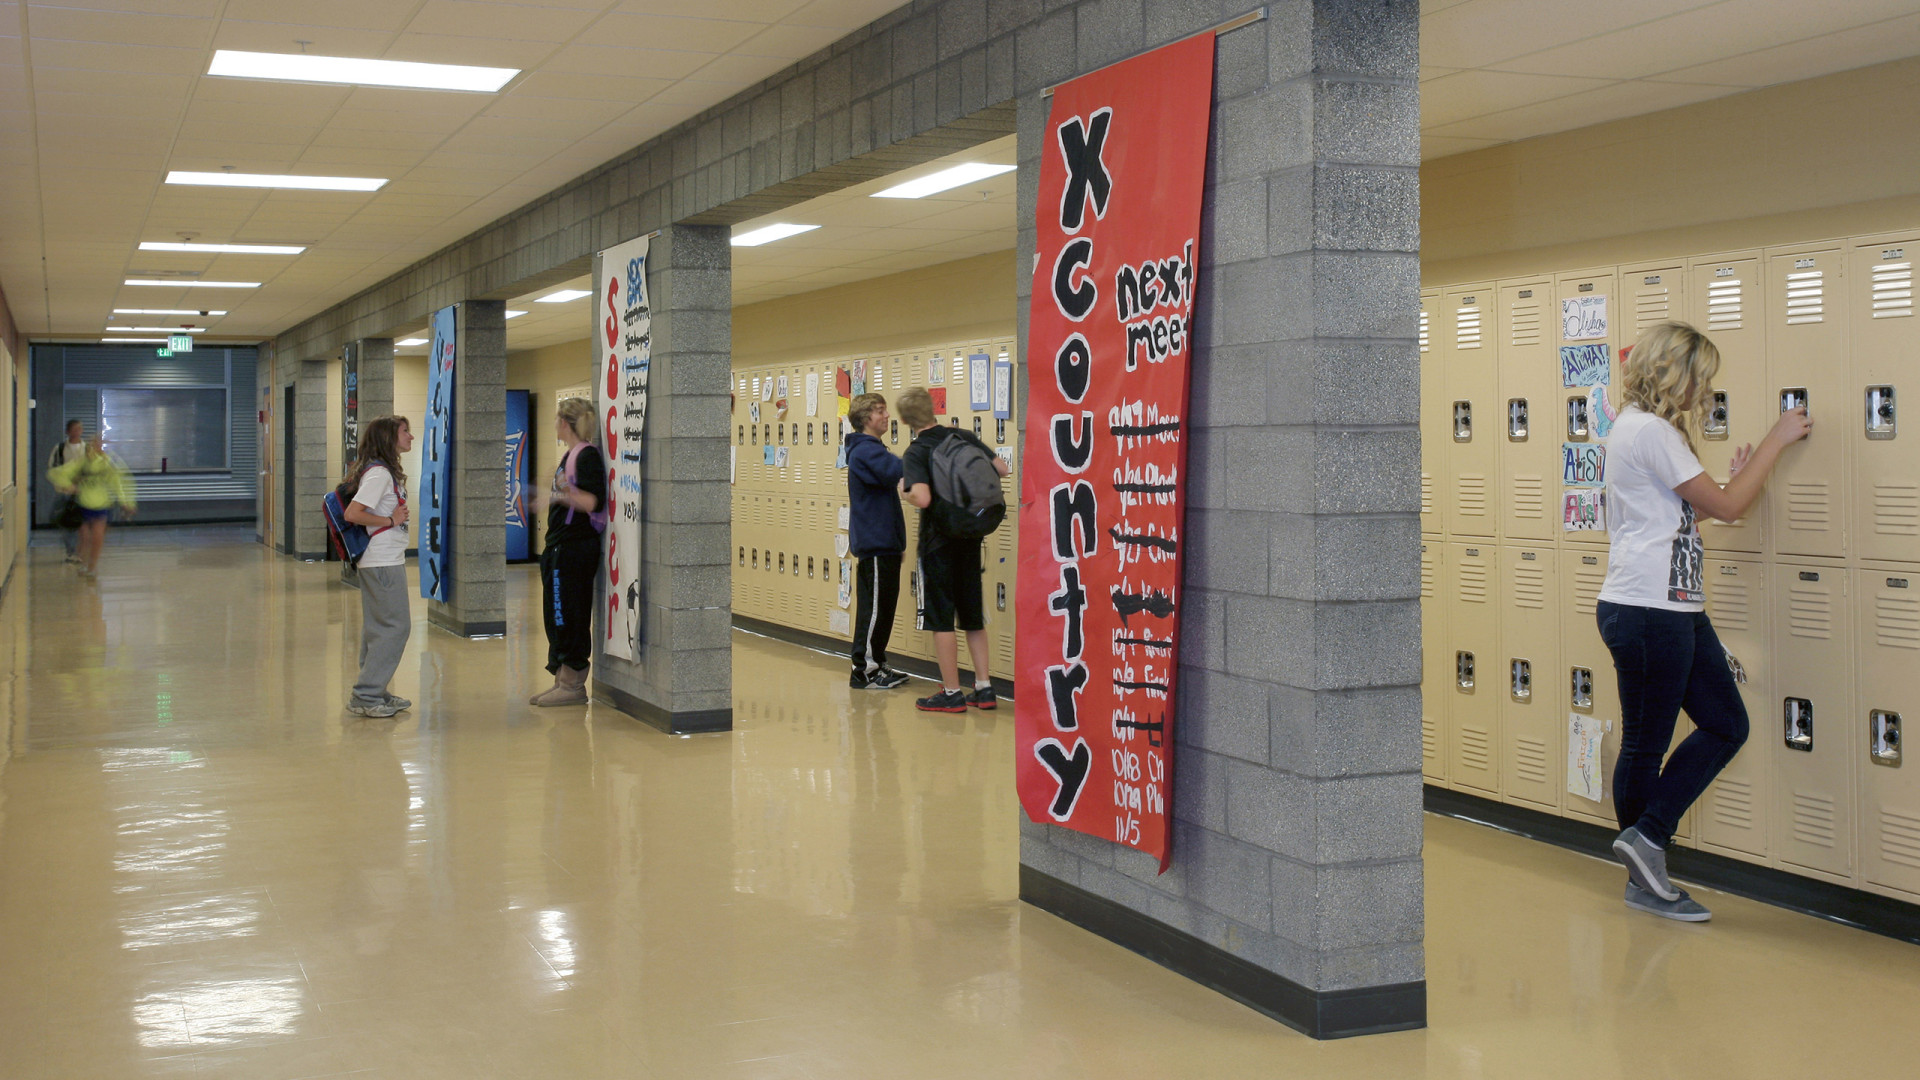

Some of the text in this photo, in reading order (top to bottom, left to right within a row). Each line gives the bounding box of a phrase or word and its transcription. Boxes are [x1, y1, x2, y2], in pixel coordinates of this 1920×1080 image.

[1057, 106, 1112, 235] X
[1114, 238, 1194, 323] next
[171, 337, 190, 351] EXIT
[553, 569, 564, 626] FREEMAN
[1115, 811, 1141, 845] 11/5
